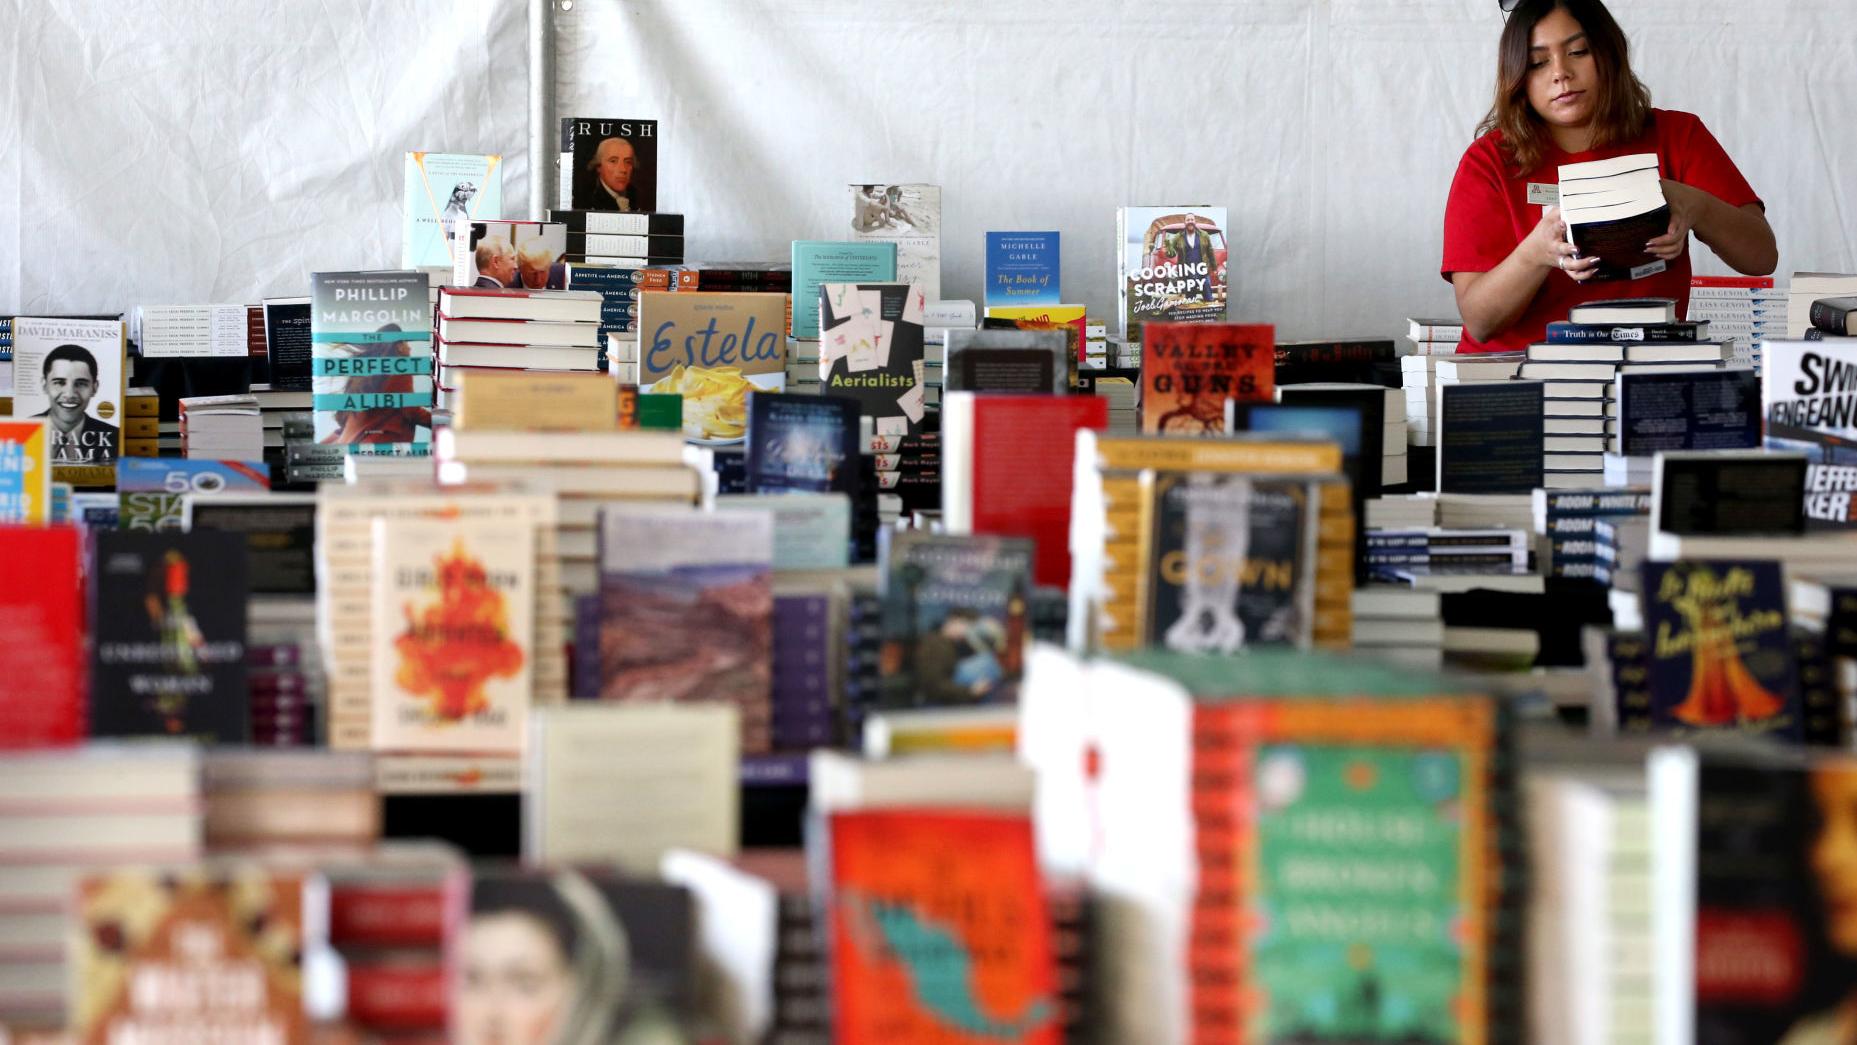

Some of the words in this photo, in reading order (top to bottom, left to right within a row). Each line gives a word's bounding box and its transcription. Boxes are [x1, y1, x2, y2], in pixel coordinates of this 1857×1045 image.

[578, 122, 653, 137] RUSH
[1130, 262, 1208, 281] COOKING
[998, 274, 1013, 284] The
[1016, 274, 1037, 284] Book
[1040, 274, 1050, 286] of
[1134, 278, 1206, 296] SCRAPPY
[336, 288, 408, 301] PHILLIP
[1006, 286, 1040, 296] Summer
[292, 318, 314, 326] spin
[322, 310, 421, 322] MARGOLIN
[18, 326, 54, 336] DAVID
[57, 328, 118, 338] MARANISS
[1564, 330, 1586, 338] Truth
[1613, 328, 1640, 338] Times
[646, 316, 781, 373] Estela
[1154, 344, 1256, 358] VALLEY
[324, 358, 422, 374] PERFECT
[832, 374, 914, 388] Aerialists
[1154, 374, 1256, 393] GUNS
[345, 394, 403, 408] ALIBI
[51, 430, 112, 446] RACK
[56, 448, 111, 462] AMA
[165, 471, 225, 494] 50
[128, 492, 184, 516] STA
[1555, 495, 1594, 508] ROOM
[1804, 493, 1850, 522] KER
[1160, 551, 1292, 589] GOWN
